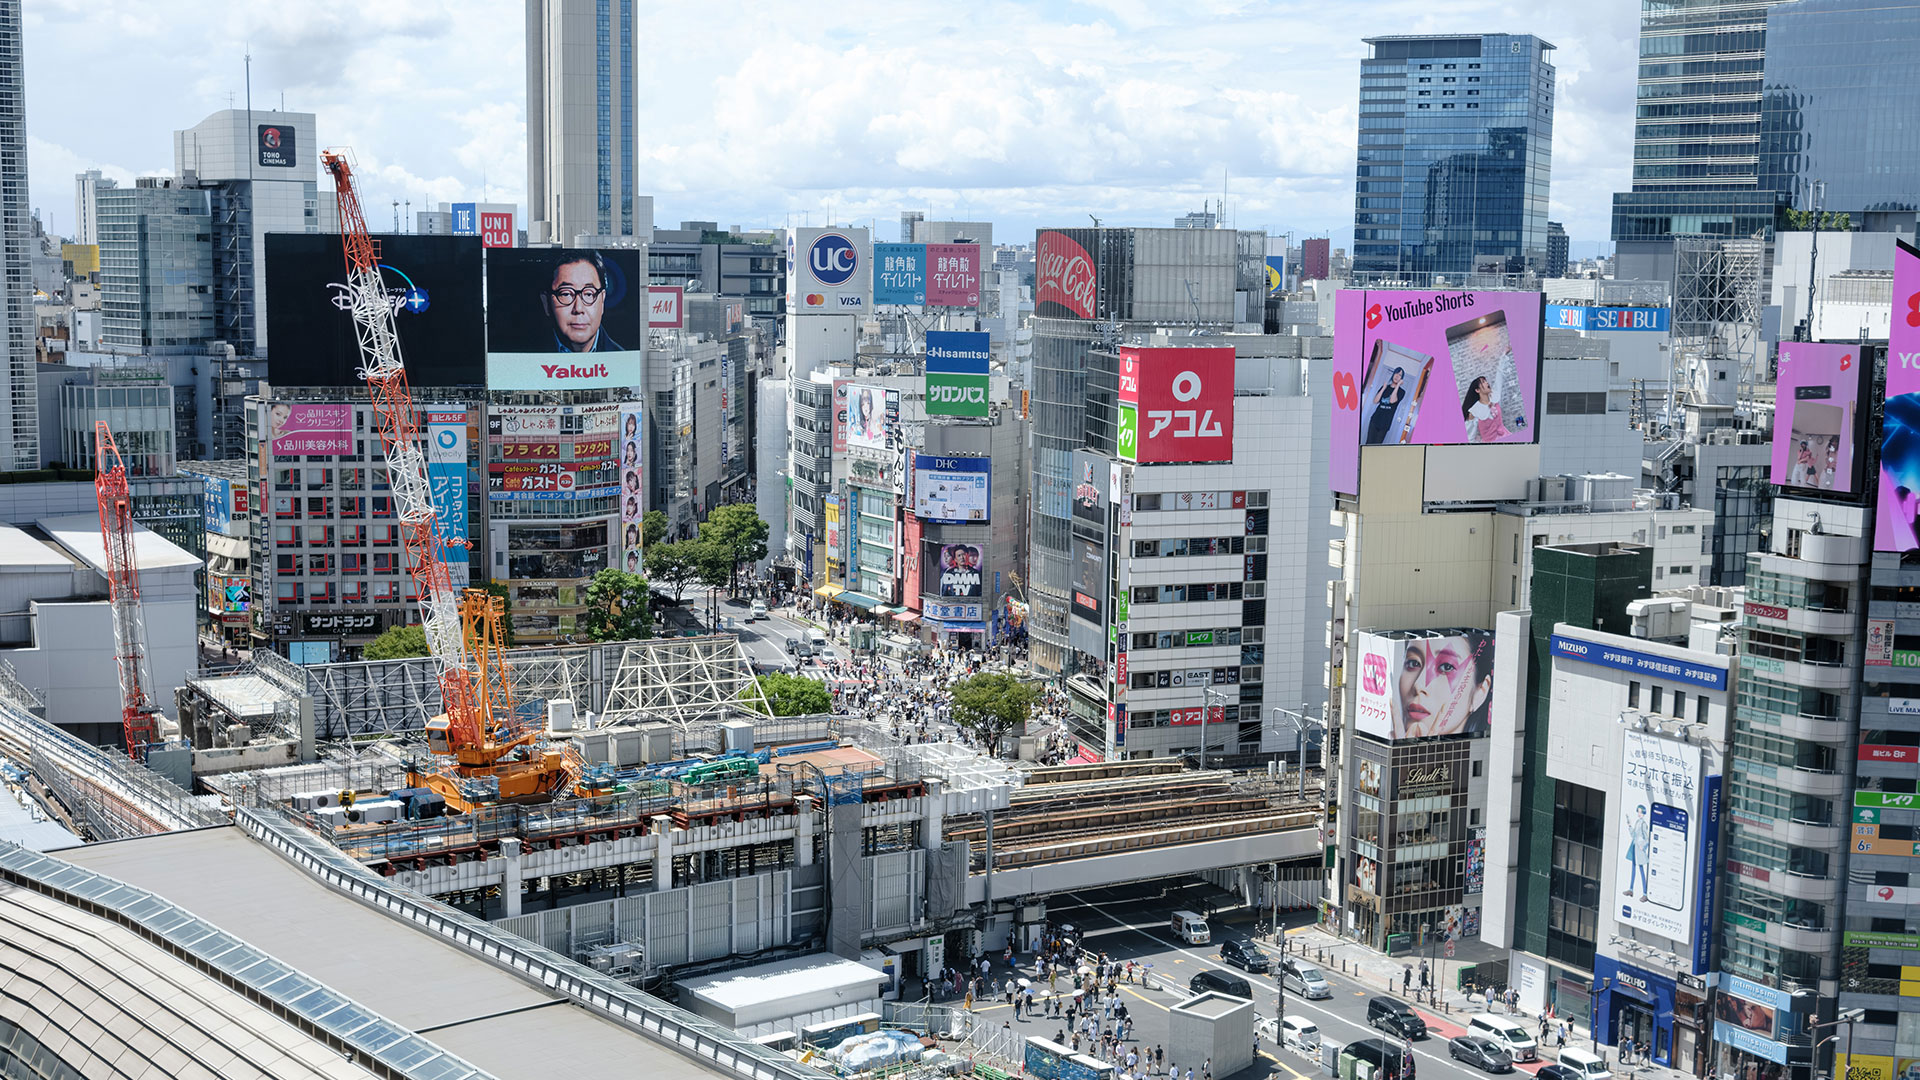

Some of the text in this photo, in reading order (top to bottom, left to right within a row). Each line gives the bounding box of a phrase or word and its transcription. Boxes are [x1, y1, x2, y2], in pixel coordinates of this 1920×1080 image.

[457, 210, 470, 230] THE
[484, 217, 508, 230] UNI
[484, 231, 510, 246] QLO
[884, 256, 916, 272] 龍角散
[937, 257, 969, 273] 龍角散
[880, 273, 922, 288] ダイレクト
[933, 274, 975, 289] ダイレクト
[1037, 241, 1096, 318] Coca-Cola
[652, 300, 673, 314] H&M
[840, 297, 862, 306] VISA
[1384, 291, 1475, 322] YouTube Shorts
[1559, 308, 1583, 327] SEIBU
[1597, 310, 1657, 328] SEIBU
[927, 346, 989, 359] Hisamitsu
[541, 363, 609, 379] Yakult
[1120, 376, 1137, 393] アコム
[929, 385, 986, 404] サロンパス
[306, 409, 348, 418] 品川スキン
[581, 404, 620, 413] しゃぶしゃぶバイキング
[307, 419, 345, 427] クリニック
[1118, 408, 1135, 448] レイク
[1147, 409, 1223, 439] アコム
[283, 440, 349, 451] 品川美容外科
[503, 444, 558, 456] プライス
[574, 441, 610, 455] コンタクト
[539, 463, 566, 474] ガスト
[600, 460, 618, 471] ガスト
[935, 458, 958, 469] DHC
[489, 478, 503, 487] 7F
[521, 476, 555, 490] ガスト
[167, 508, 200, 516] CITY
[943, 573, 981, 585] DMM
[953, 584, 971, 596] TV
[924, 604, 977, 617] 大盛堂書店
[310, 615, 375, 628] サンドラッグ
[1190, 633, 1209, 641] レイク
[1558, 640, 1718, 683] MIZUHO みずほ銀行 みずほ信託銀行 みずほ証券
[1360, 703, 1387, 721] ワクワク
[1634, 749, 1688, 770] 信号待ちのあなた
[1893, 750, 1906, 758] 8F
[1405, 767, 1441, 785] Lindt
[1627, 762, 1694, 790] スマホで振込
[1711, 788, 1719, 823] MIZUHO
[1882, 794, 1914, 806] レイク
[1856, 826, 1875, 835] 賃貸
[1857, 840, 1872, 851] 6F
[1632, 914, 1683, 935] みずほダイレクトアプリ
[1616, 970, 1647, 989] MIZUHO
[1848, 978, 1860, 988] 3F
[1732, 980, 1778, 1000] intimissimi
